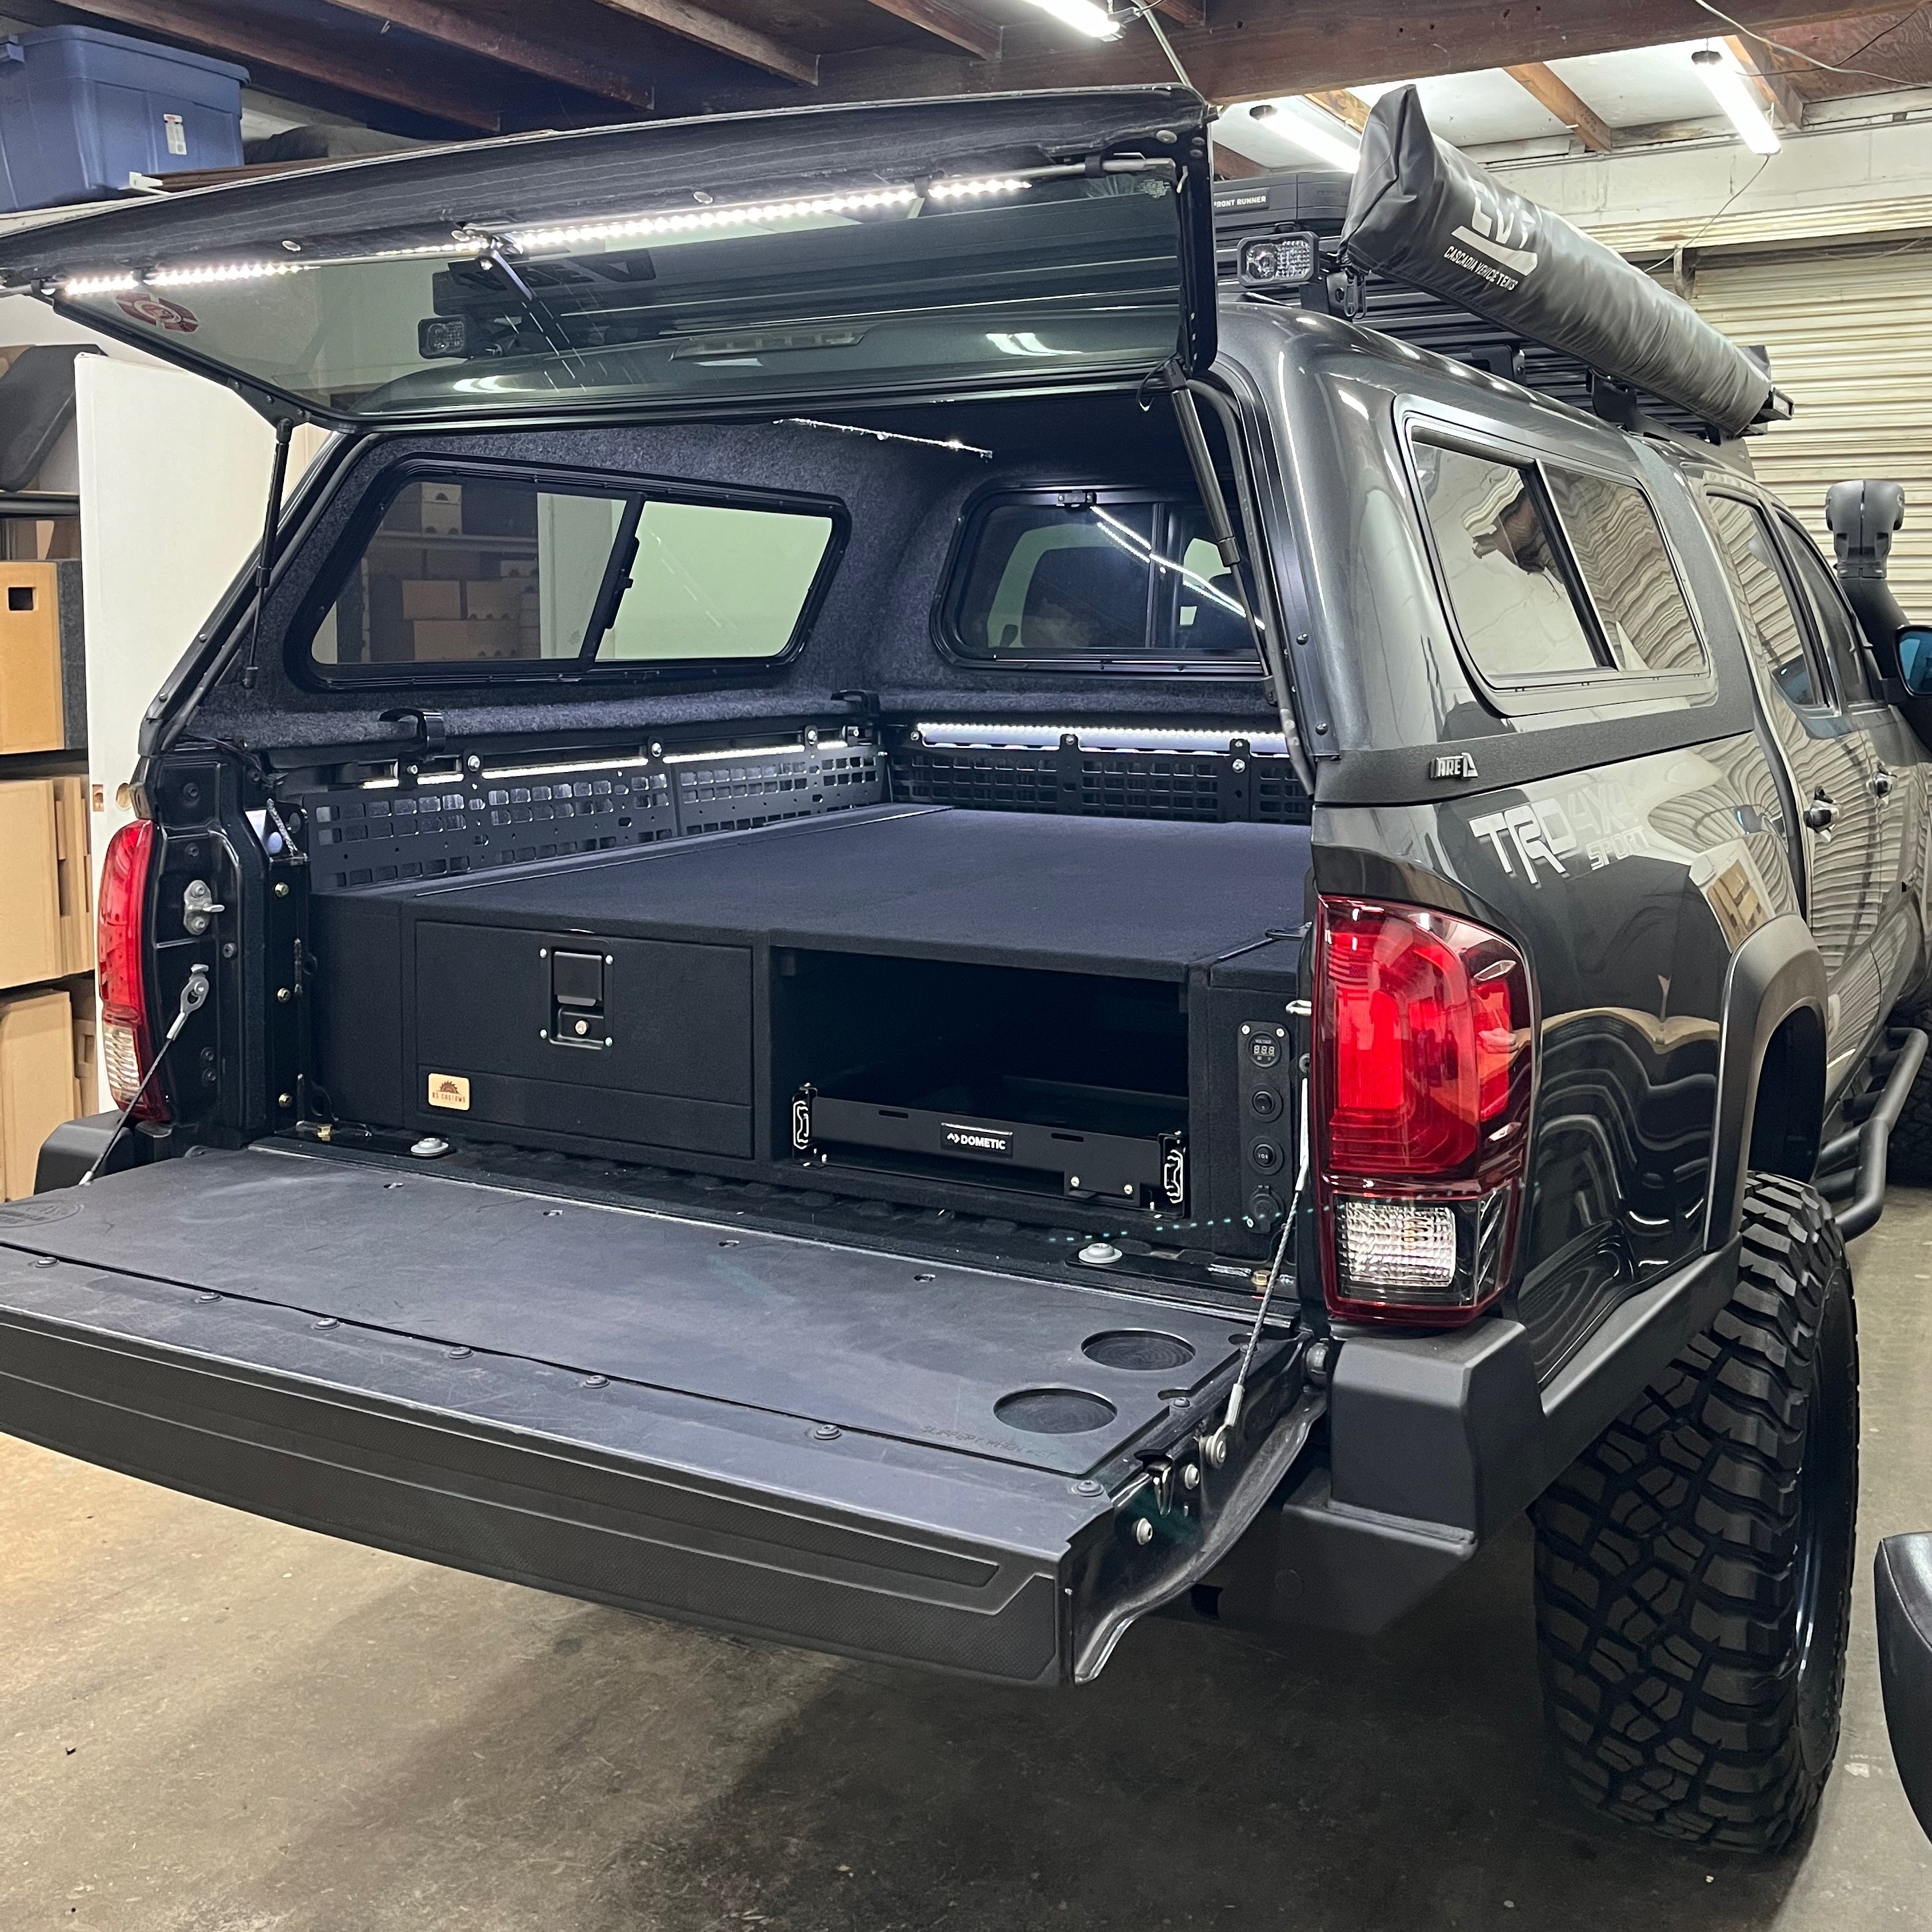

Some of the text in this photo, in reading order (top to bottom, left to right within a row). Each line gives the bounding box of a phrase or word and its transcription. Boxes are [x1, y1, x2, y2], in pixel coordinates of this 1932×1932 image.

[1237, 195, 1267, 205] RUNNER
[1443, 245, 1478, 271] CASCADIA
[1468, 798, 1577, 885] TRD
[1586, 825, 1650, 871] SPORT
[961, 1134, 1006, 1150] DOMETIC
[922, 1425, 984, 1443] SLIPPERY
[987, 1439, 1025, 1452] WHEN
